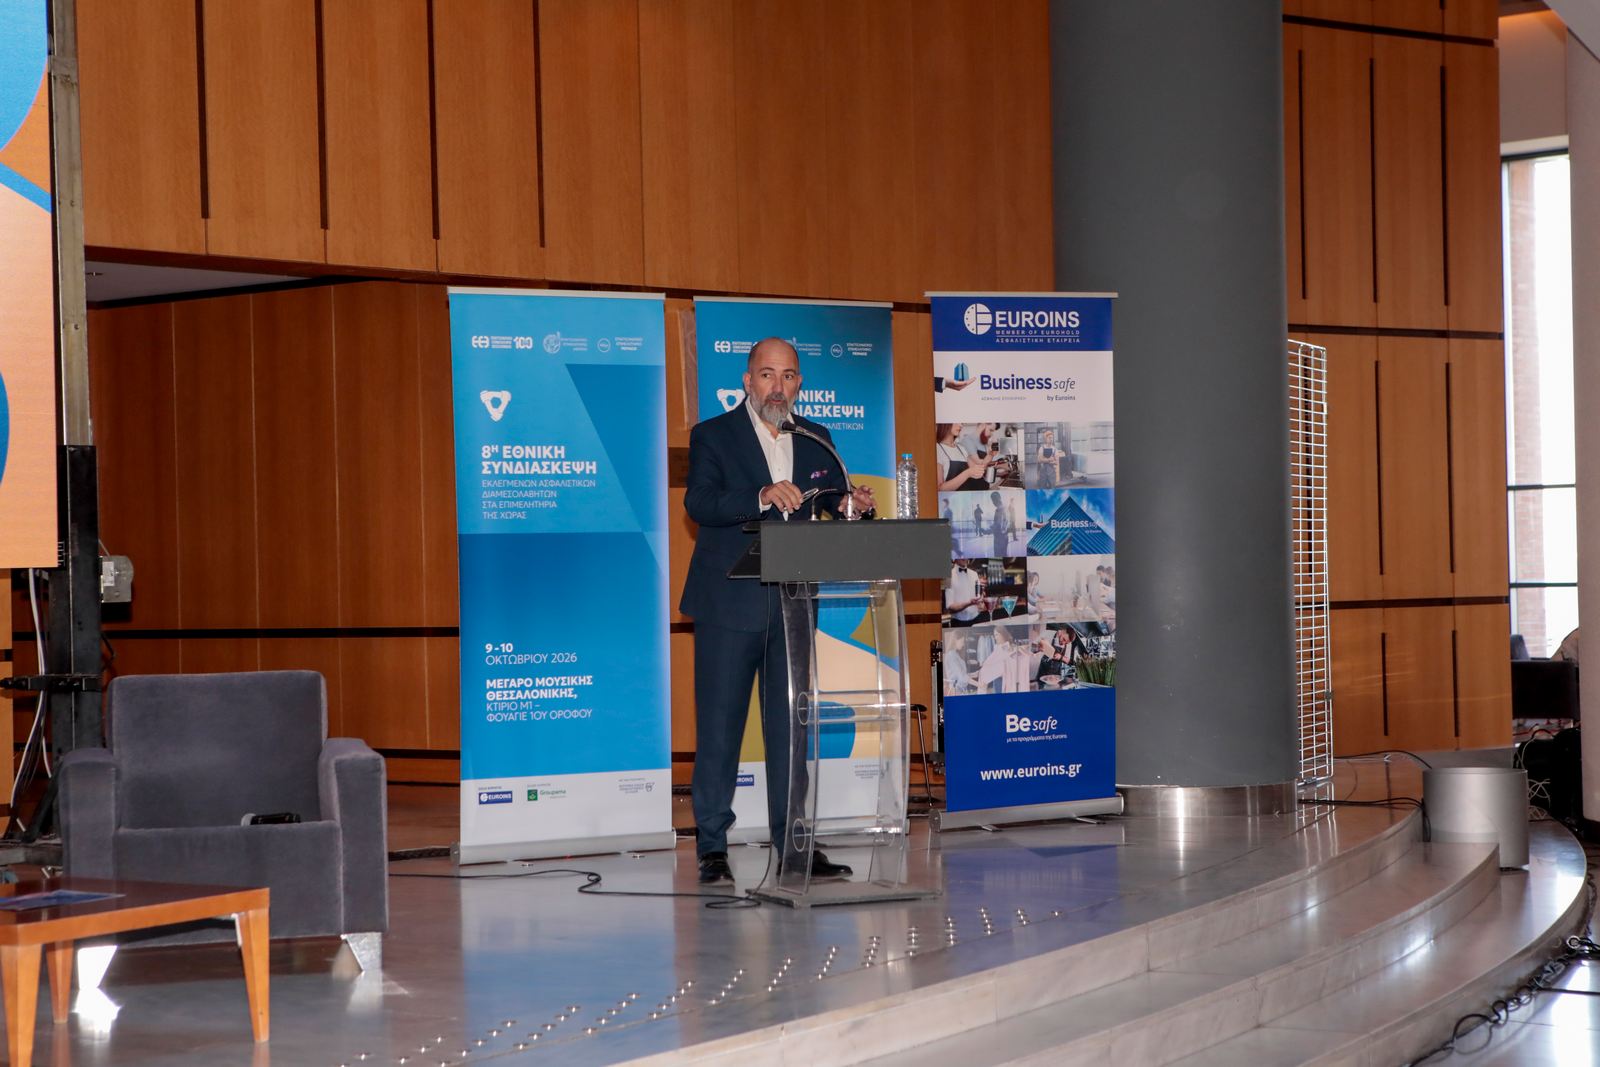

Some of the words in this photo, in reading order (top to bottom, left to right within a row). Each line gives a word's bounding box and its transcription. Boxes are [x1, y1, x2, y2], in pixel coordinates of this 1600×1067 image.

[995, 311, 1080, 328] EUROINS
[980, 374, 1052, 390] Business
[1053, 378, 1076, 393] safe
[798, 390, 835, 403] ΝΙΚΗ
[793, 405, 865, 418] ΙΑΣΚΕΨΗ
[502, 445, 565, 459] ΕΘΝΙΚΗ
[481, 461, 597, 474] ΣΥΝΔΙΑΣΚΕΨΗ
[481, 480, 537, 488] ΕΚΛΕΓΜΕΝΩΝ
[539, 479, 596, 488] ΑΣΦΑΛΙΣΤΙΚΩΝ
[481, 490, 557, 498] ΔΙΑΜΕΣΟΛΑΒΗΤΩΝ
[499, 500, 557, 508] ΕΠΙΜΕΛΗΤΗΡΙΑ
[482, 511, 498, 519] ΤΗΣ
[500, 511, 527, 519] ΧΩΡΑΣ
[1051, 519, 1089, 528] Business
[485, 654, 548, 665] ΟΚΤΩΒΡΙΟΥ
[551, 653, 577, 663] 2026
[486, 677, 533, 689] ΜΕΓΑΡΟ
[535, 675, 593, 687] ΜΟΥΣΙΚΗΣ
[486, 688, 578, 701] ΘΕΣΣΑΛΟΝΙΚΗΣ,
[486, 702, 518, 711] ΚΤΙΡΙΟ
[520, 701, 533, 709] Μ1
[486, 711, 527, 722] ΦΟΥΑΓΙΕ
[549, 709, 592, 719] ΟΡΟΦΟΥ
[1005, 714, 1031, 733] Be
[1032, 716, 1058, 733] safe
[980, 763, 1082, 781] www.euroins.gr
